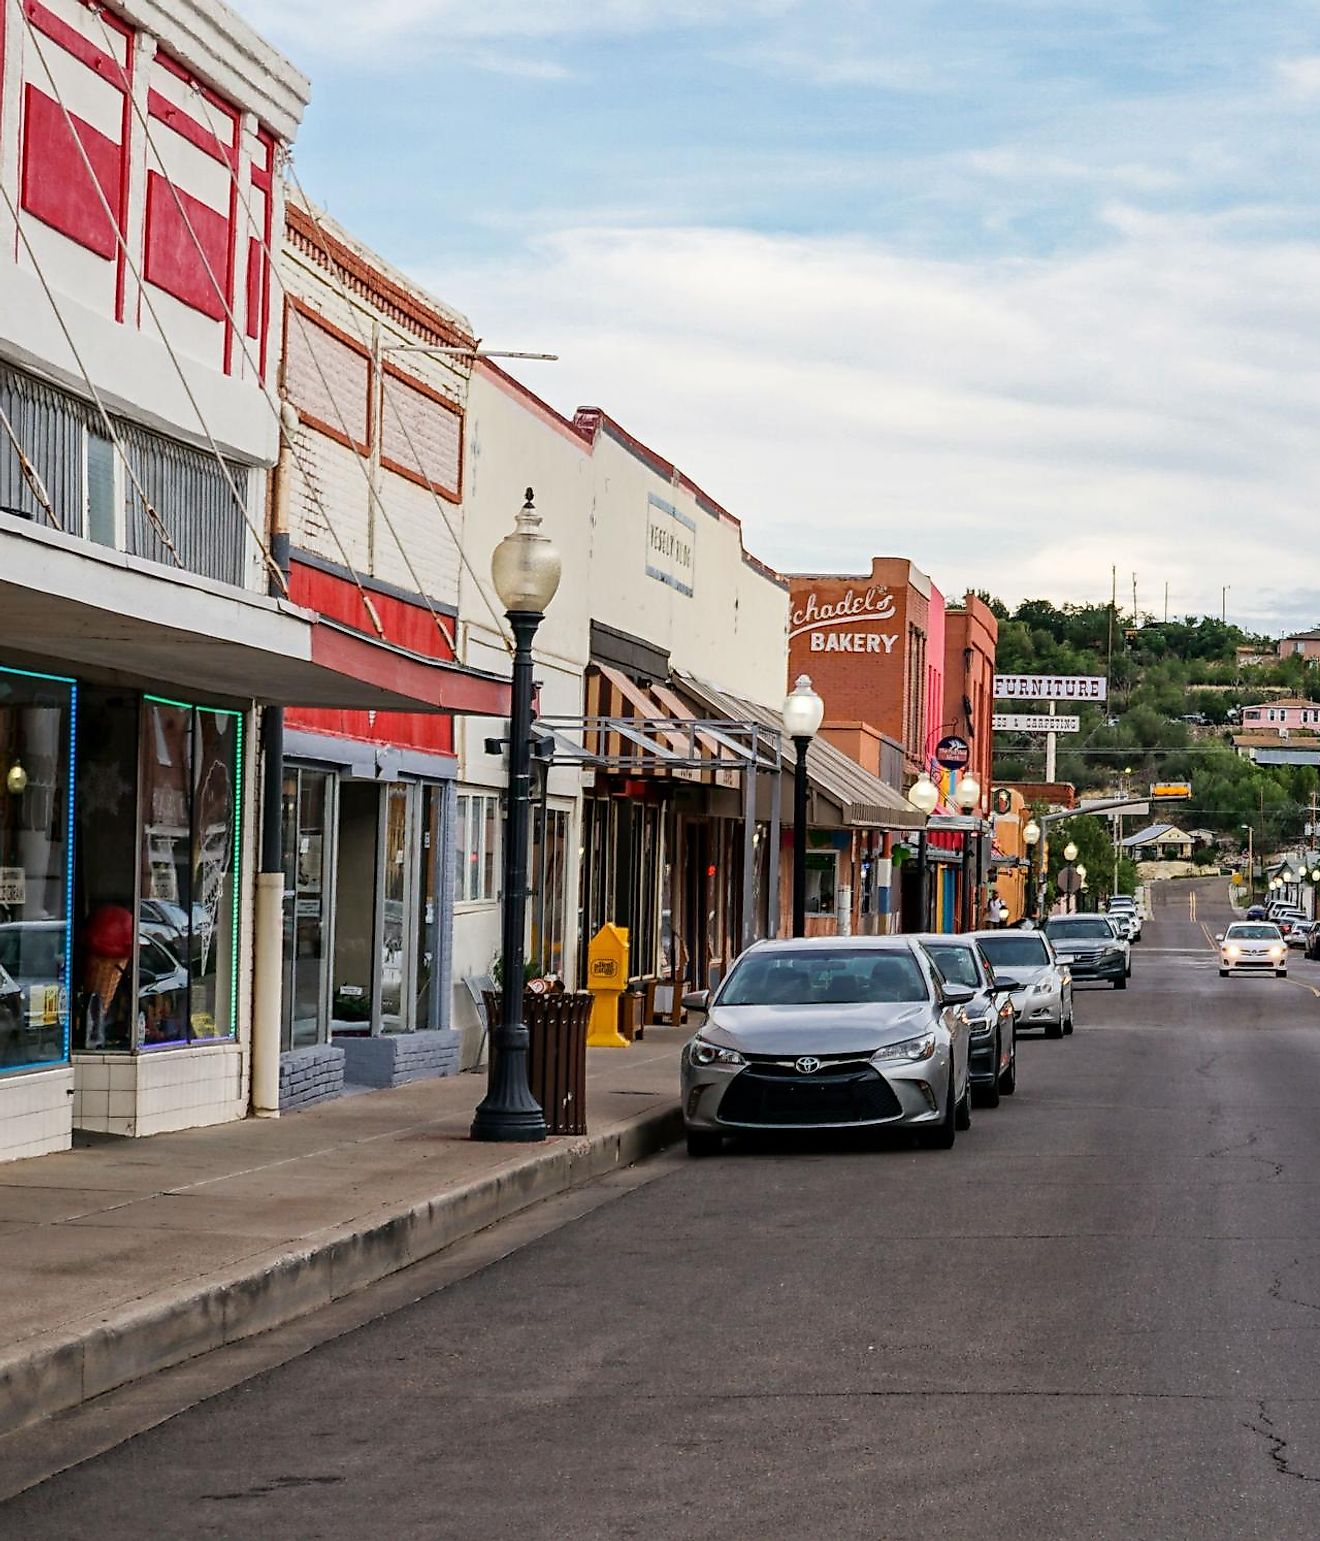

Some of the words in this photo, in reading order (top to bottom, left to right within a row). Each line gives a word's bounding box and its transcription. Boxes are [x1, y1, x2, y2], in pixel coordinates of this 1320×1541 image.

[789, 585, 894, 625] chadel's
[810, 632, 899, 654] BAKERY
[995, 678, 1099, 697] FURNITURE
[1026, 717, 1076, 729] CARPETING
